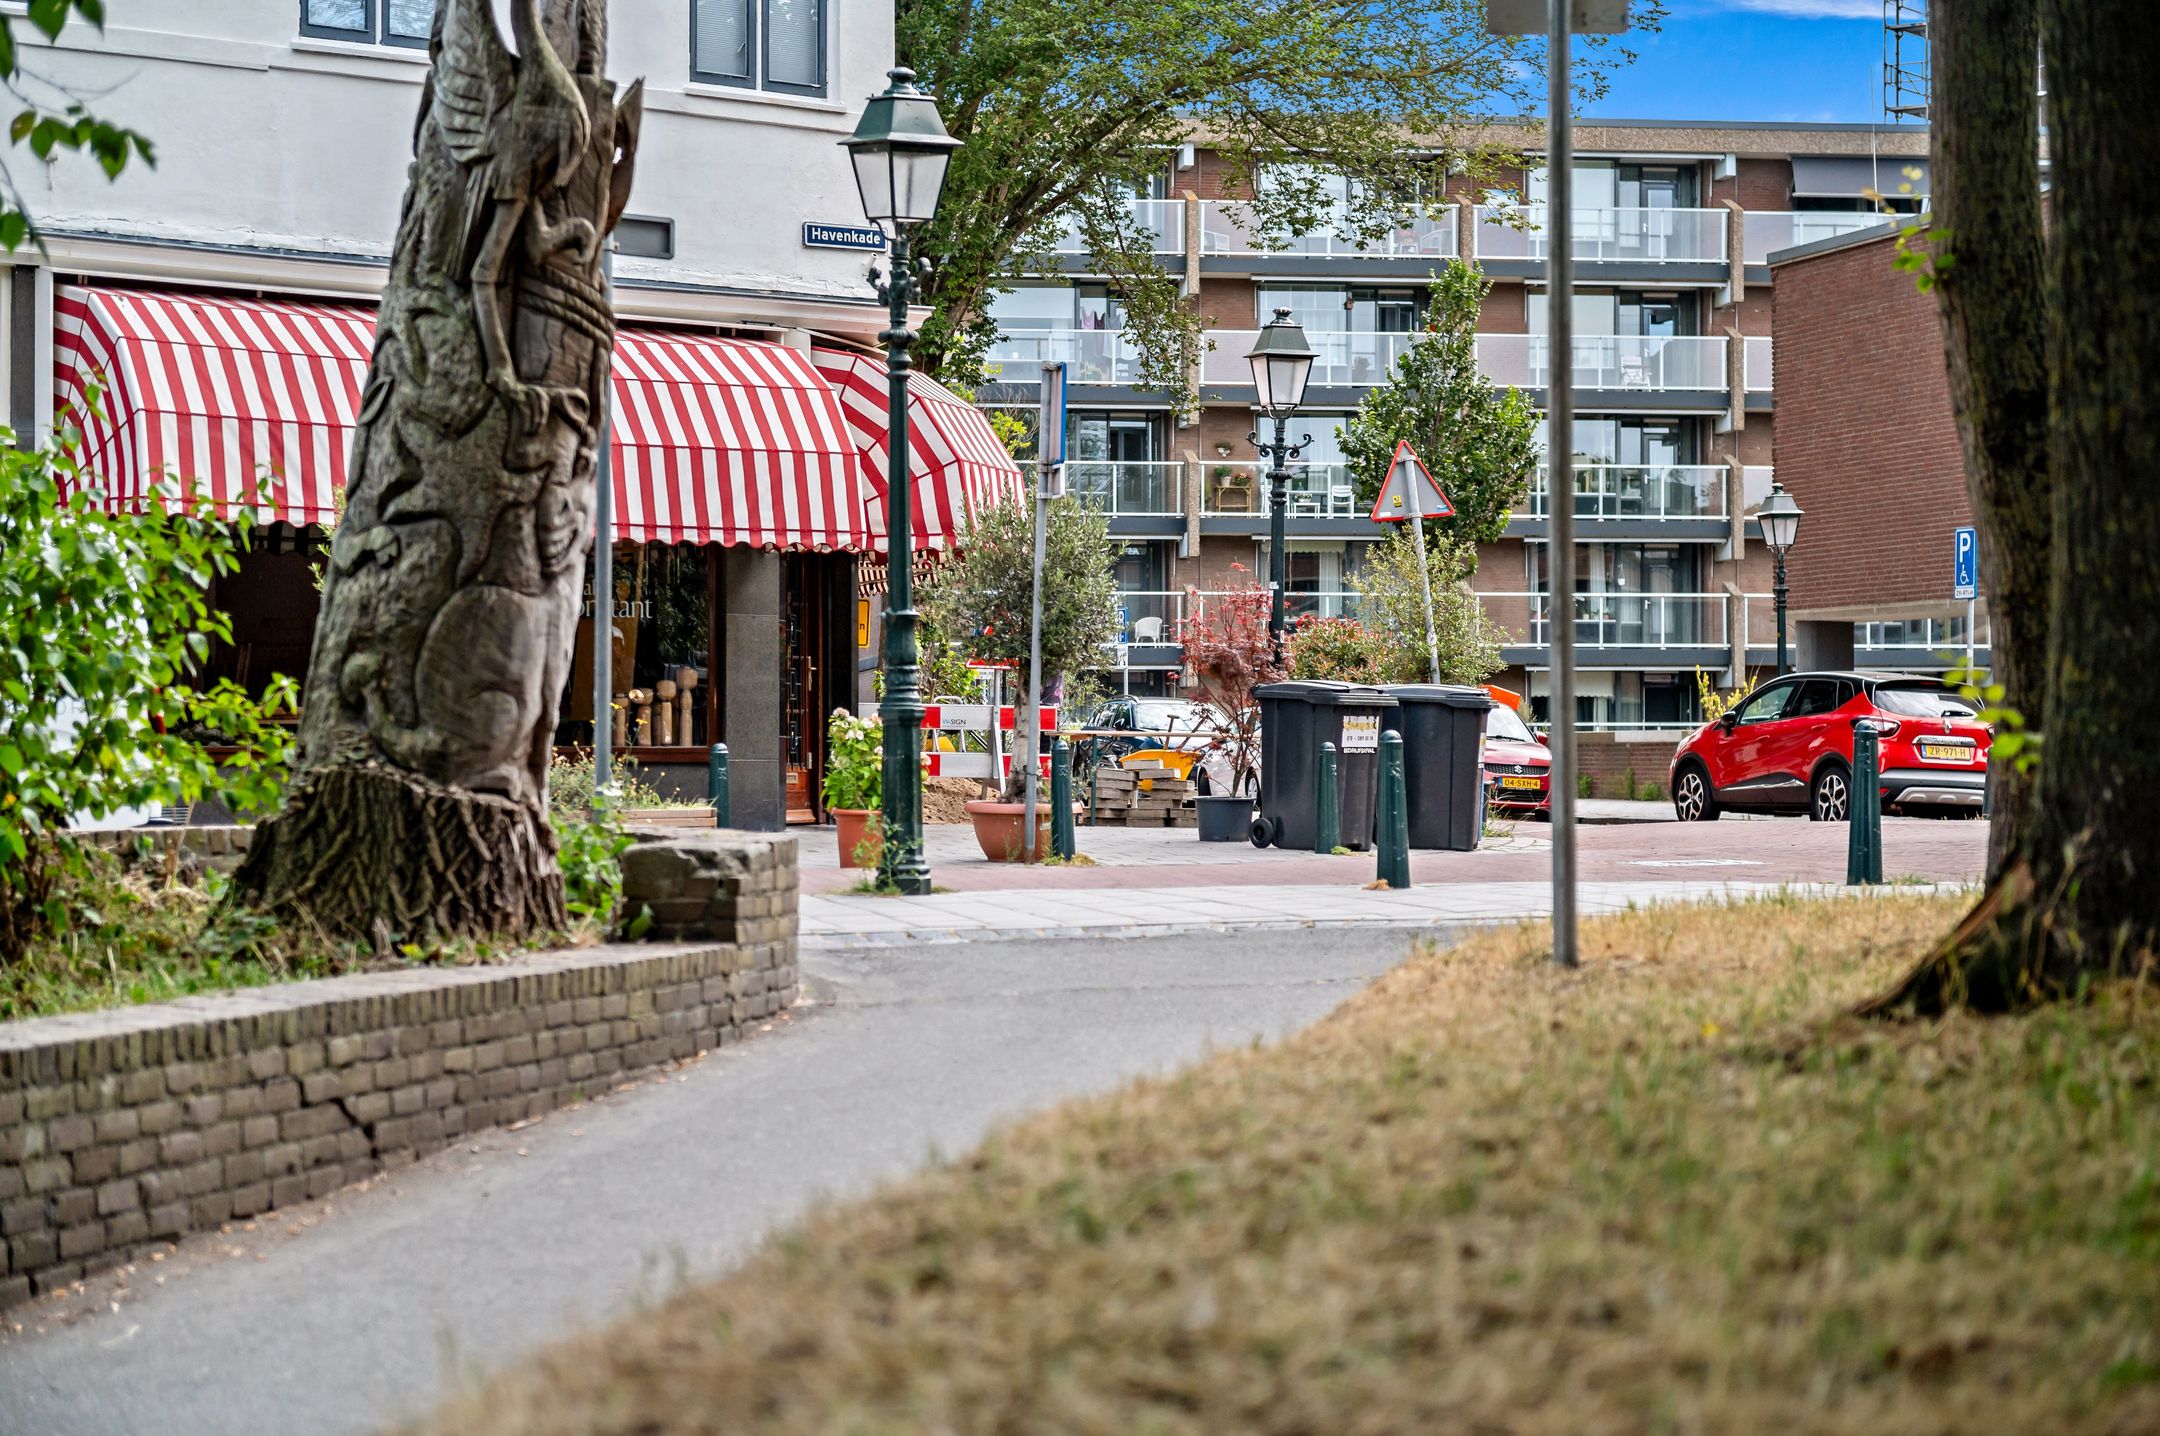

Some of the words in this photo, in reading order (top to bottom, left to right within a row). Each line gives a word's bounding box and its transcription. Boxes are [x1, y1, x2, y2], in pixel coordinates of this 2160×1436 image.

[811, 227, 881, 245] Havenkade
[1959, 532, 1971, 563] P
[1929, 746, 1966, 757] ZR-971-H
[1504, 778, 1539, 788] 04-SXH-4
